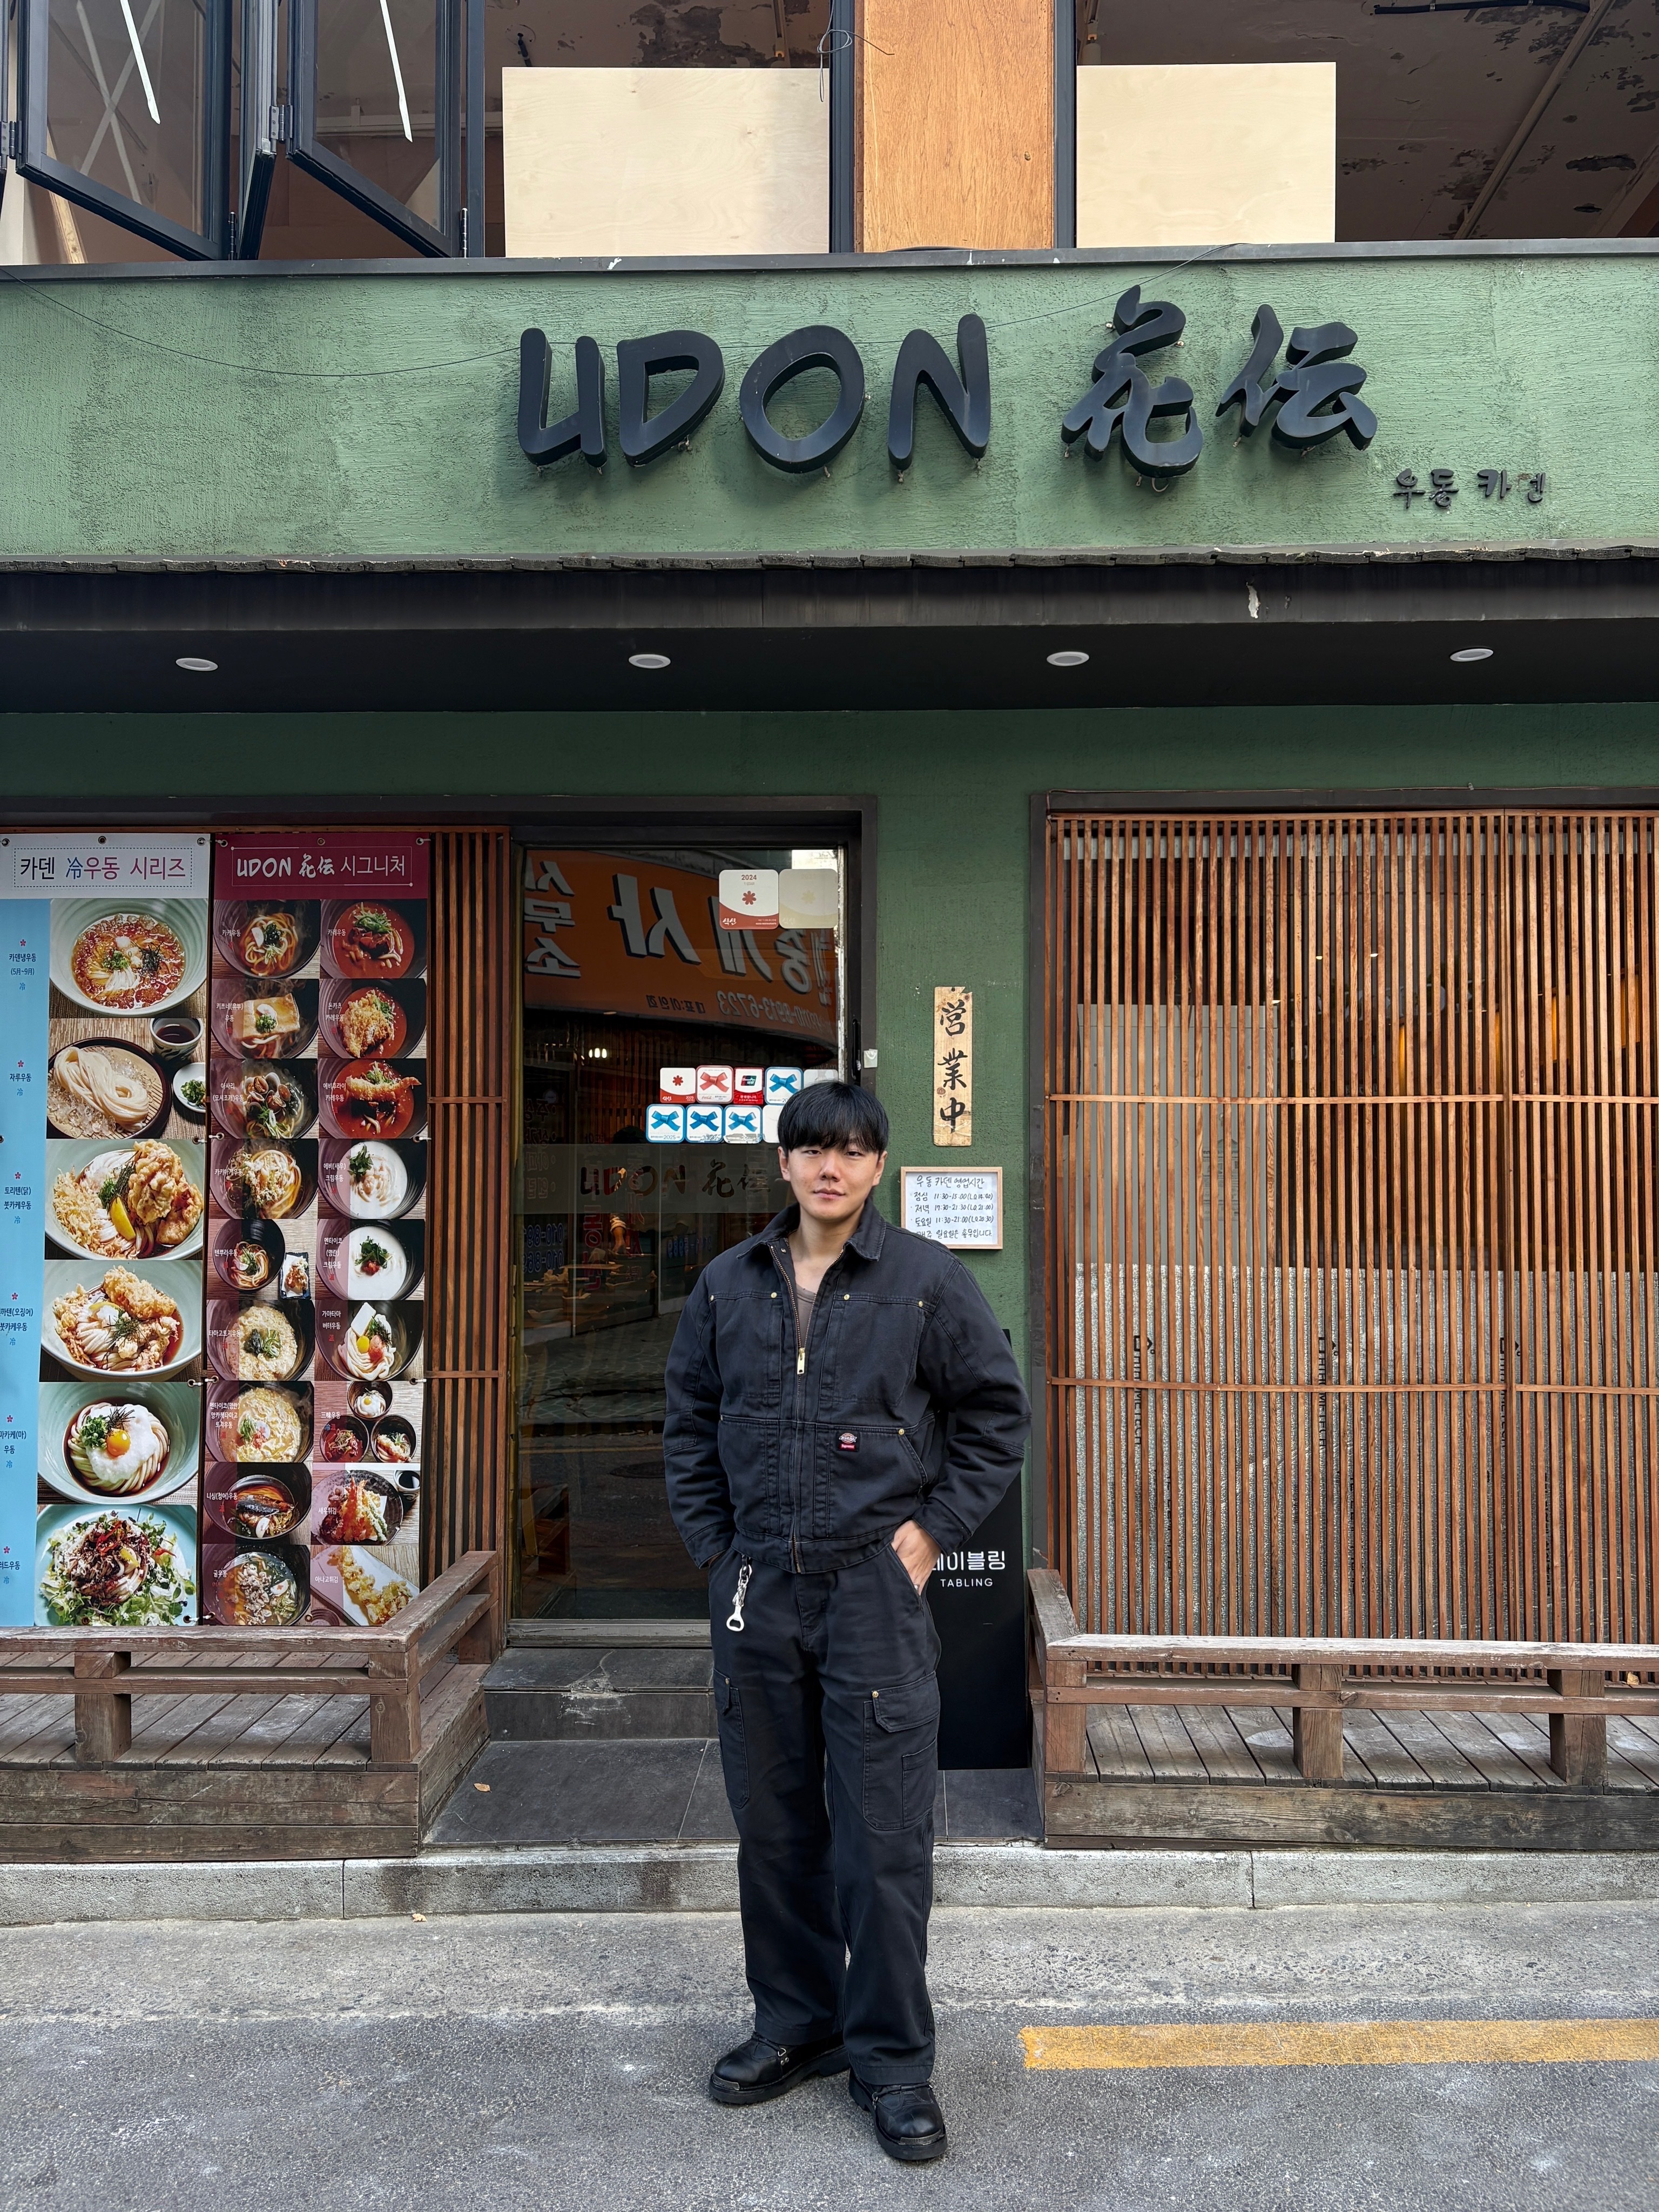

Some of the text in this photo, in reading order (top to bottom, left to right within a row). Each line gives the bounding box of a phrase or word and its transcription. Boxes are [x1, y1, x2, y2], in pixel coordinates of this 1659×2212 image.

[517, 313, 992, 471] UDON
[1393, 468, 1459, 509] 우동
[21, 857, 186, 880] 카덴 冷우동 시리즈
[237, 857, 292, 878] UDON
[340, 855, 405, 876] 시그니처
[9, 953, 37, 962] 카덴냉우동
[11, 968, 35, 976] (5月~9月)
[10, 1073, 32, 1082] 자루우동
[935, 1177, 952, 1188] 카덴
[954, 1177, 984, 1189] 영업시간
[4, 1186, 31, 1196] 토리텐(닭)
[914, 1192, 928, 1201] 점심
[4, 1201, 31, 1210] 붓카케우동
[915, 1204, 929, 1214] 저녁
[915, 1217, 932, 1227] 토요일
[936, 1230, 959, 1239] 일요일은
[0, 1307, 33, 1318] 까텐(오징어)
[0, 1323, 28, 1332] 붓카케우동
[4, 1445, 15, 1454] 우동
[940, 1578, 993, 1587] TABLING
